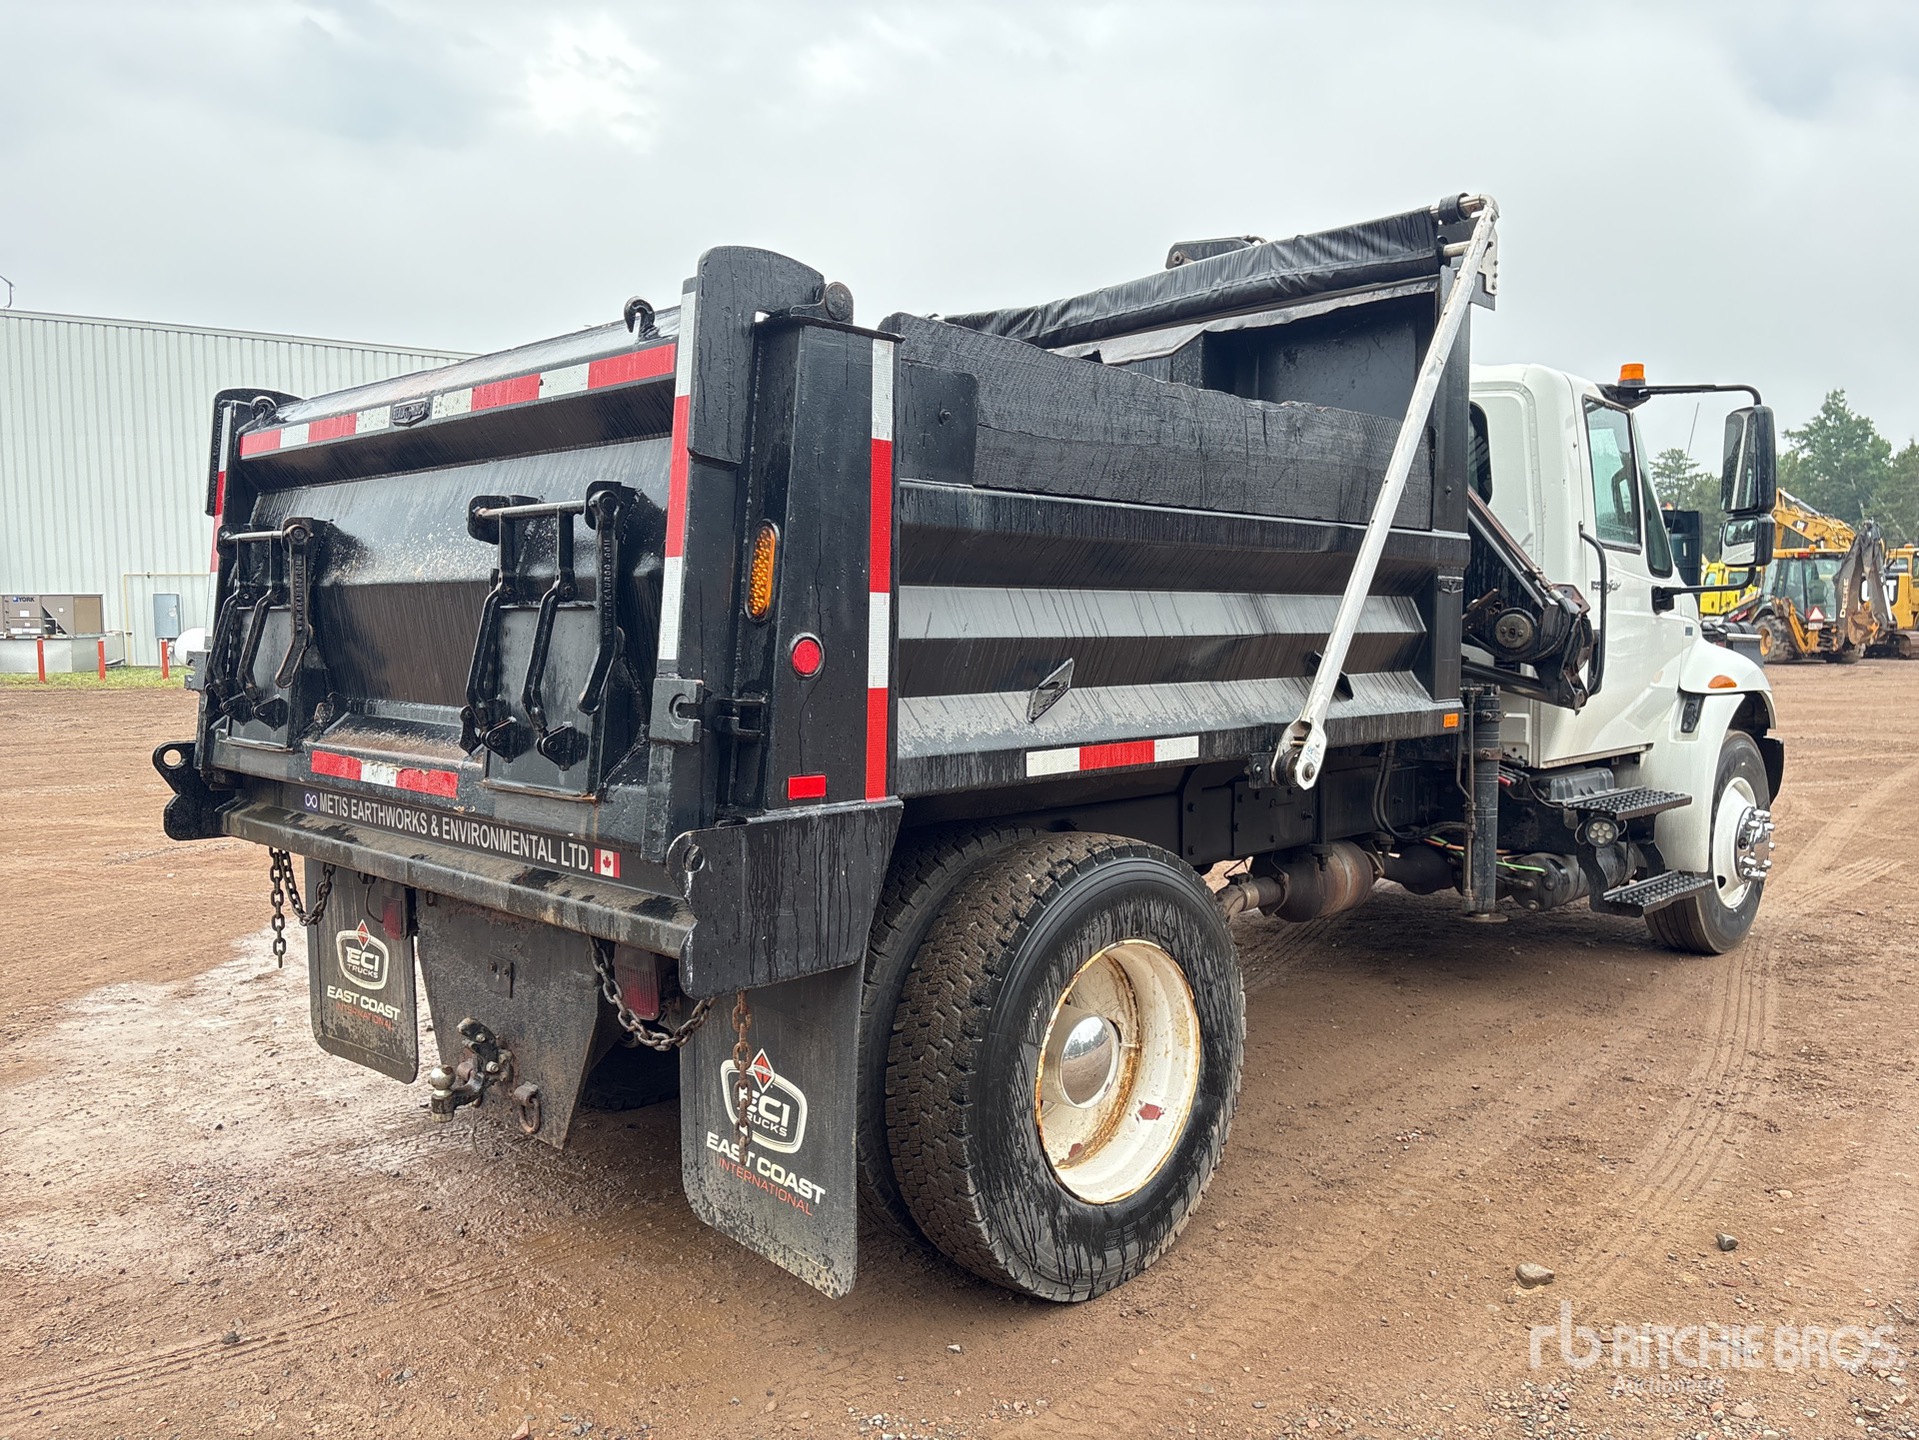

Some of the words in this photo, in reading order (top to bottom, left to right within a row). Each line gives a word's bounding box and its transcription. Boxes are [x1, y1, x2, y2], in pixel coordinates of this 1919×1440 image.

[1840, 578, 1850, 617] DEERE
[1861, 580, 1898, 602] CT
[320, 792, 349, 818] METIS
[351, 798, 428, 835] EARTHWORKS
[430, 815, 439, 837] &
[442, 816, 557, 864] ENVIRONMENTAL
[561, 841, 594, 872] LTD.
[346, 946, 380, 972] ECI
[347, 963, 379, 979] TRUCKS
[327, 985, 359, 1005] EAST
[360, 996, 401, 1021] COAST
[336, 1002, 394, 1032] INTERNATIONAL
[738, 1109, 788, 1137] RUCKS
[718, 1157, 813, 1217] INTERNATIONAL
[756, 1156, 826, 1205] COAST
